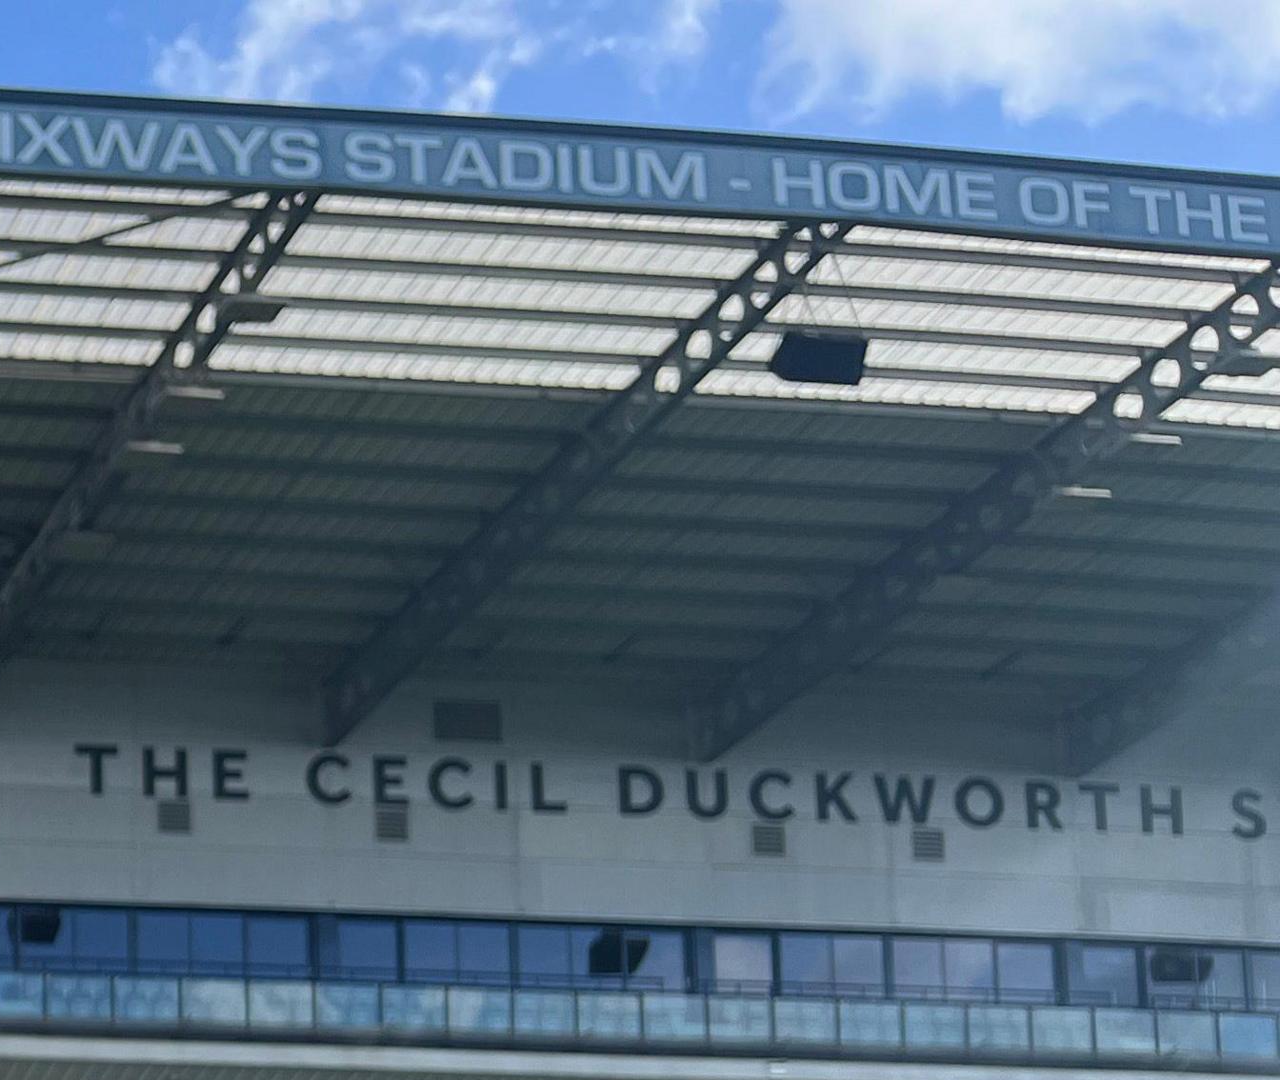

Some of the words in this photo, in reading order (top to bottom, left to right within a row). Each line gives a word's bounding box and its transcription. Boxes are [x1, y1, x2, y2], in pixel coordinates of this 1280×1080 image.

[344, 130, 707, 200] STADIUM
[772, 157, 998, 221] HOME
[1018, 175, 1111, 229] OF
[1129, 185, 1270, 245] THE
[73, 743, 251, 801] THE
[305, 748, 569, 815] CECIL
[617, 764, 1185, 837] DUCKWORTH
